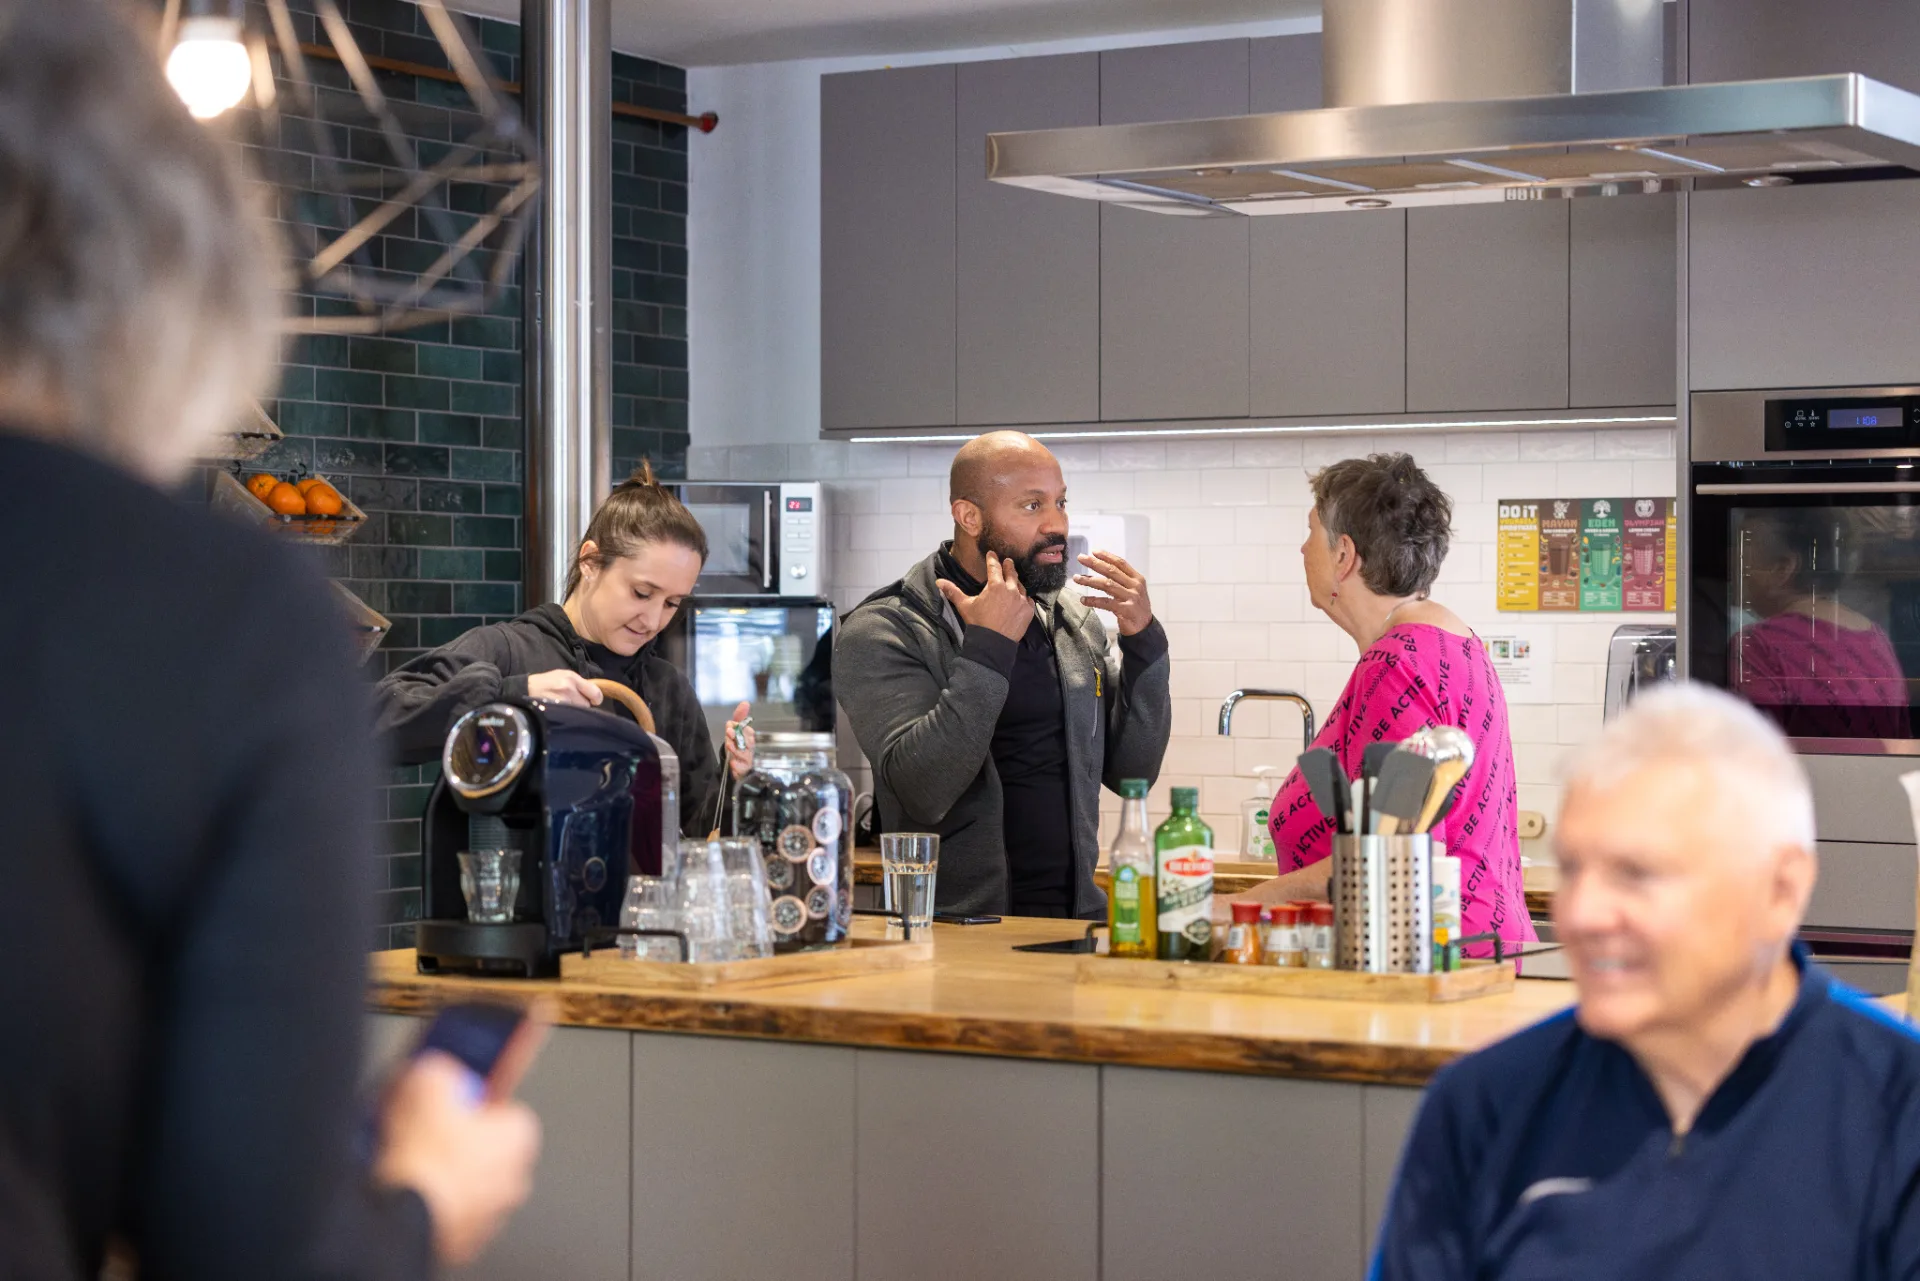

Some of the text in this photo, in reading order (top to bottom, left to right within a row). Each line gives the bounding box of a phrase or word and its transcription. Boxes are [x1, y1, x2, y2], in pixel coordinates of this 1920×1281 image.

[1500, 505, 1520, 518] DO
[1372, 675, 1426, 741] BE ACTIE
[1482, 709, 1493, 732] BE
[1463, 758, 1498, 836] BE ACTIVE
[1273, 811, 1287, 832] BE
